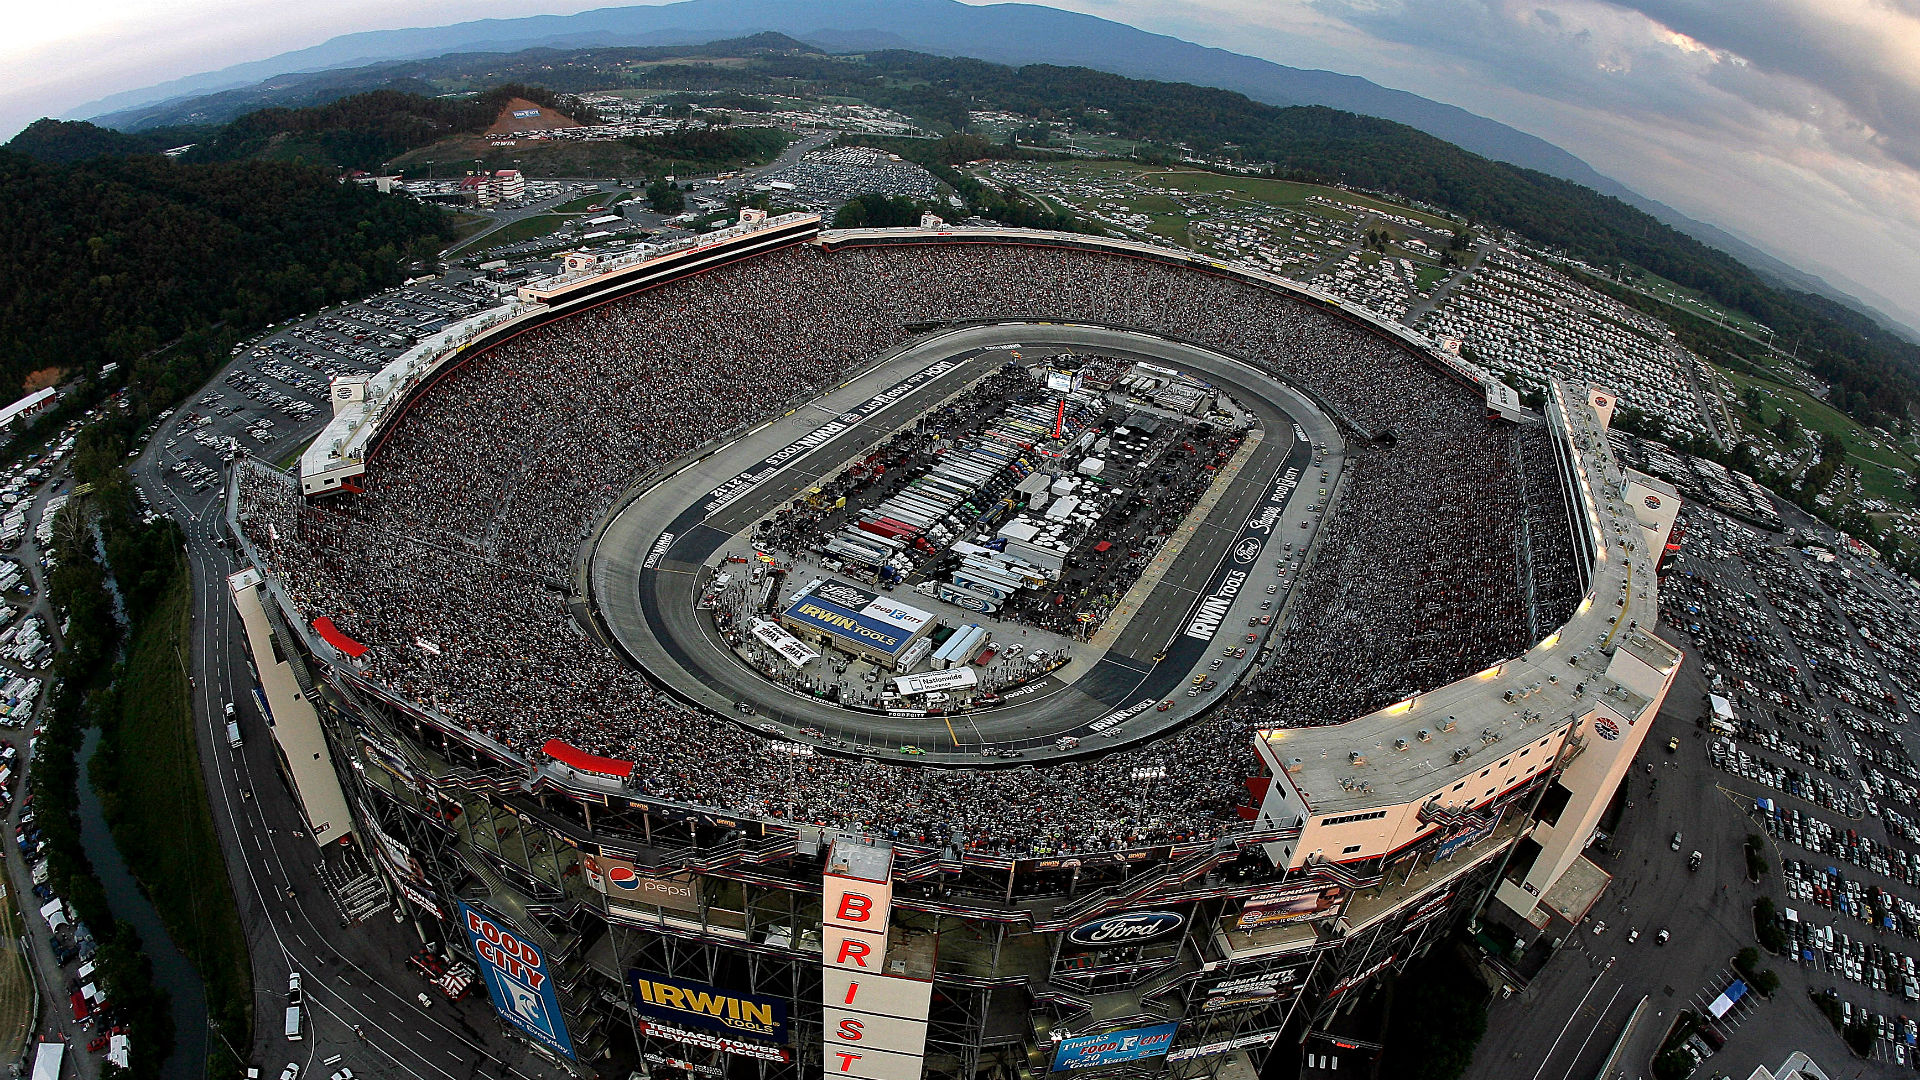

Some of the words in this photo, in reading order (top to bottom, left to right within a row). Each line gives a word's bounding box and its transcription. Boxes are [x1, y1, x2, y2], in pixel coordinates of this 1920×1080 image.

[887, 383, 913, 400] FOOD
[859, 400, 882, 413] CITY
[798, 421, 847, 449] IRWIN
[765, 443, 802, 465] TOOLS
[1271, 485, 1289, 502] FOOD
[1290, 466, 1300, 482] CITY
[653, 532, 675, 555] IRWIN
[870, 603, 892, 614] FOOD
[903, 615, 923, 624] CITY
[1186, 597, 1228, 641] IRWIN
[1221, 570, 1247, 598] TOOLS
[798, 602, 856, 630] IRWIN
[852, 626, 898, 646] TOOLS
[922, 673, 963, 685] Nationwide
[1003, 690, 1024, 700] FOOD
[1032, 681, 1049, 690] CITY
[1088, 709, 1132, 732] IRWIN
[644, 881, 692, 897] pepsi
[466, 909, 541, 968] FOOD
[1091, 916, 1164, 941] Ford
[476, 938, 546, 991] CITY
[1216, 975, 1260, 989] Richard
[1260, 968, 1297, 981] PETTY
[638, 978, 773, 1026] IRWIN
[725, 1017, 774, 1033] TOOLS
[645, 1028, 722, 1051] ELEVATOR
[724, 1046, 785, 1062] ACCESS
[647, 1022, 781, 1056] TERRACE/TOWER
[1063, 1034, 1110, 1051] Thanks
[1080, 1042, 1118, 1056] FOOD
[1139, 1033, 1172, 1046] CITY
[1063, 1057, 1079, 1067] for
[1081, 1053, 1101, 1063] 20
[1069, 1060, 1101, 1069] Great
[1102, 1055, 1134, 1065] Years!
